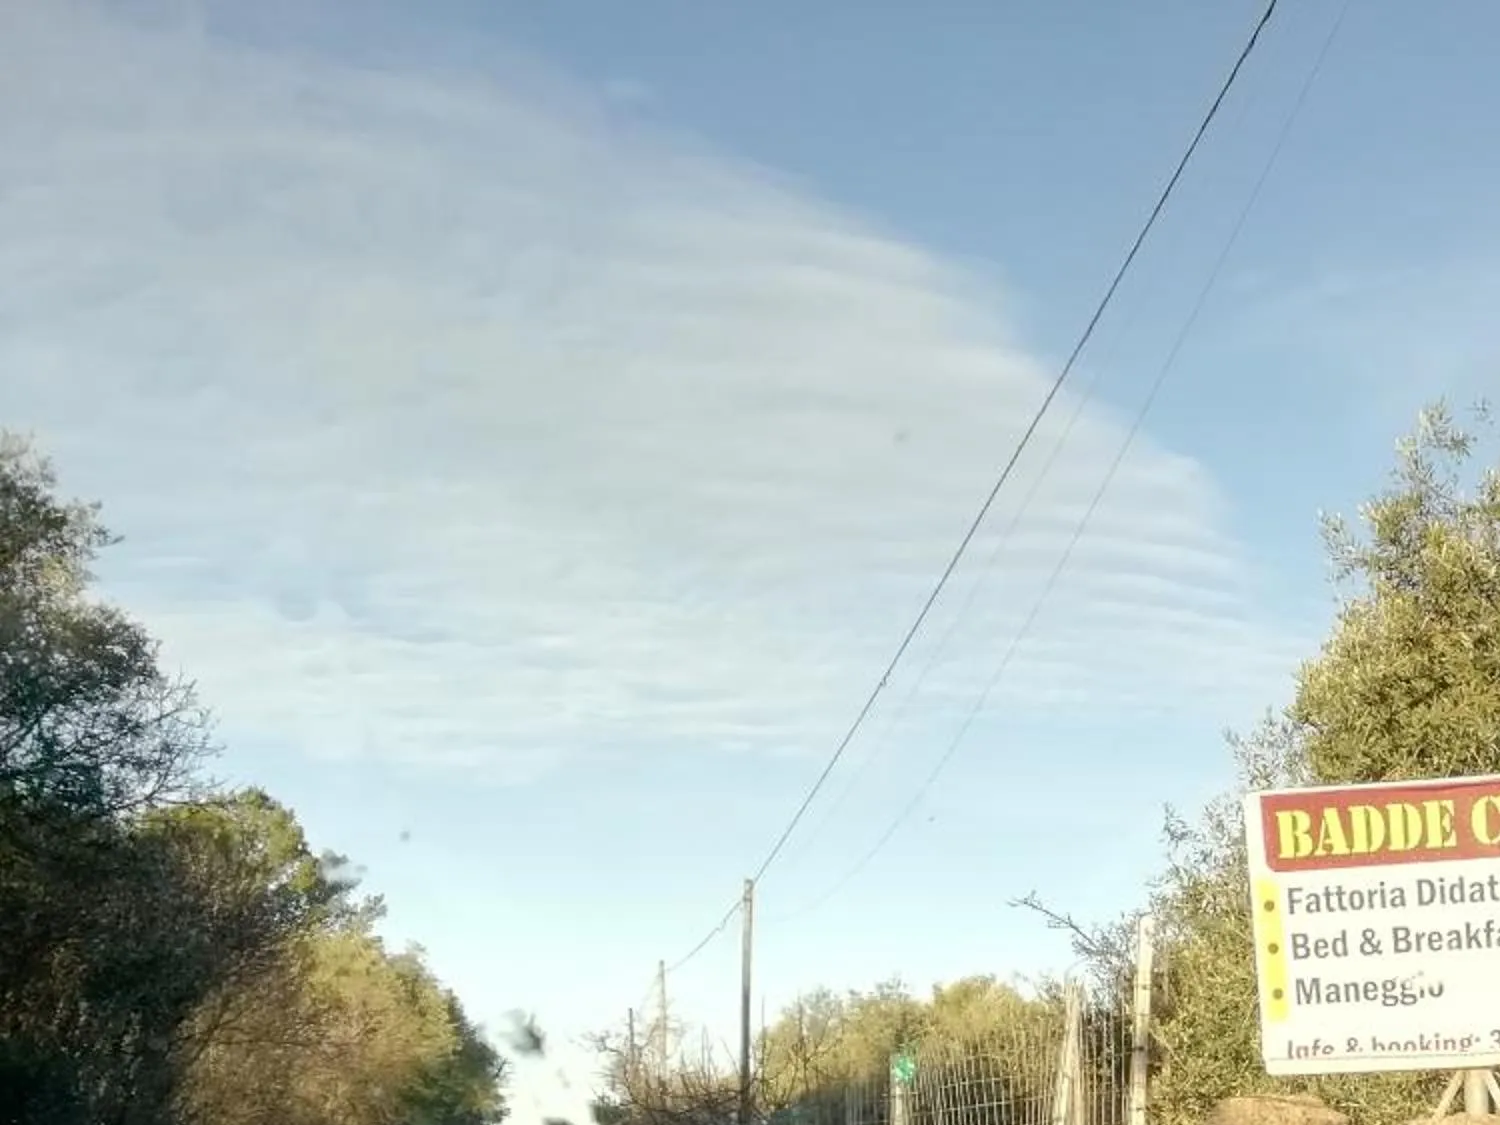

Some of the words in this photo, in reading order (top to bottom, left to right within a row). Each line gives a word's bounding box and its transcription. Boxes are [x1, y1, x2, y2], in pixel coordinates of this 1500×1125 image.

[1276, 799, 1457, 859] BADDE
[1287, 881, 1406, 914] Fattoria
[1291, 928, 1349, 960] Bed
[1359, 926, 1383, 956] &
